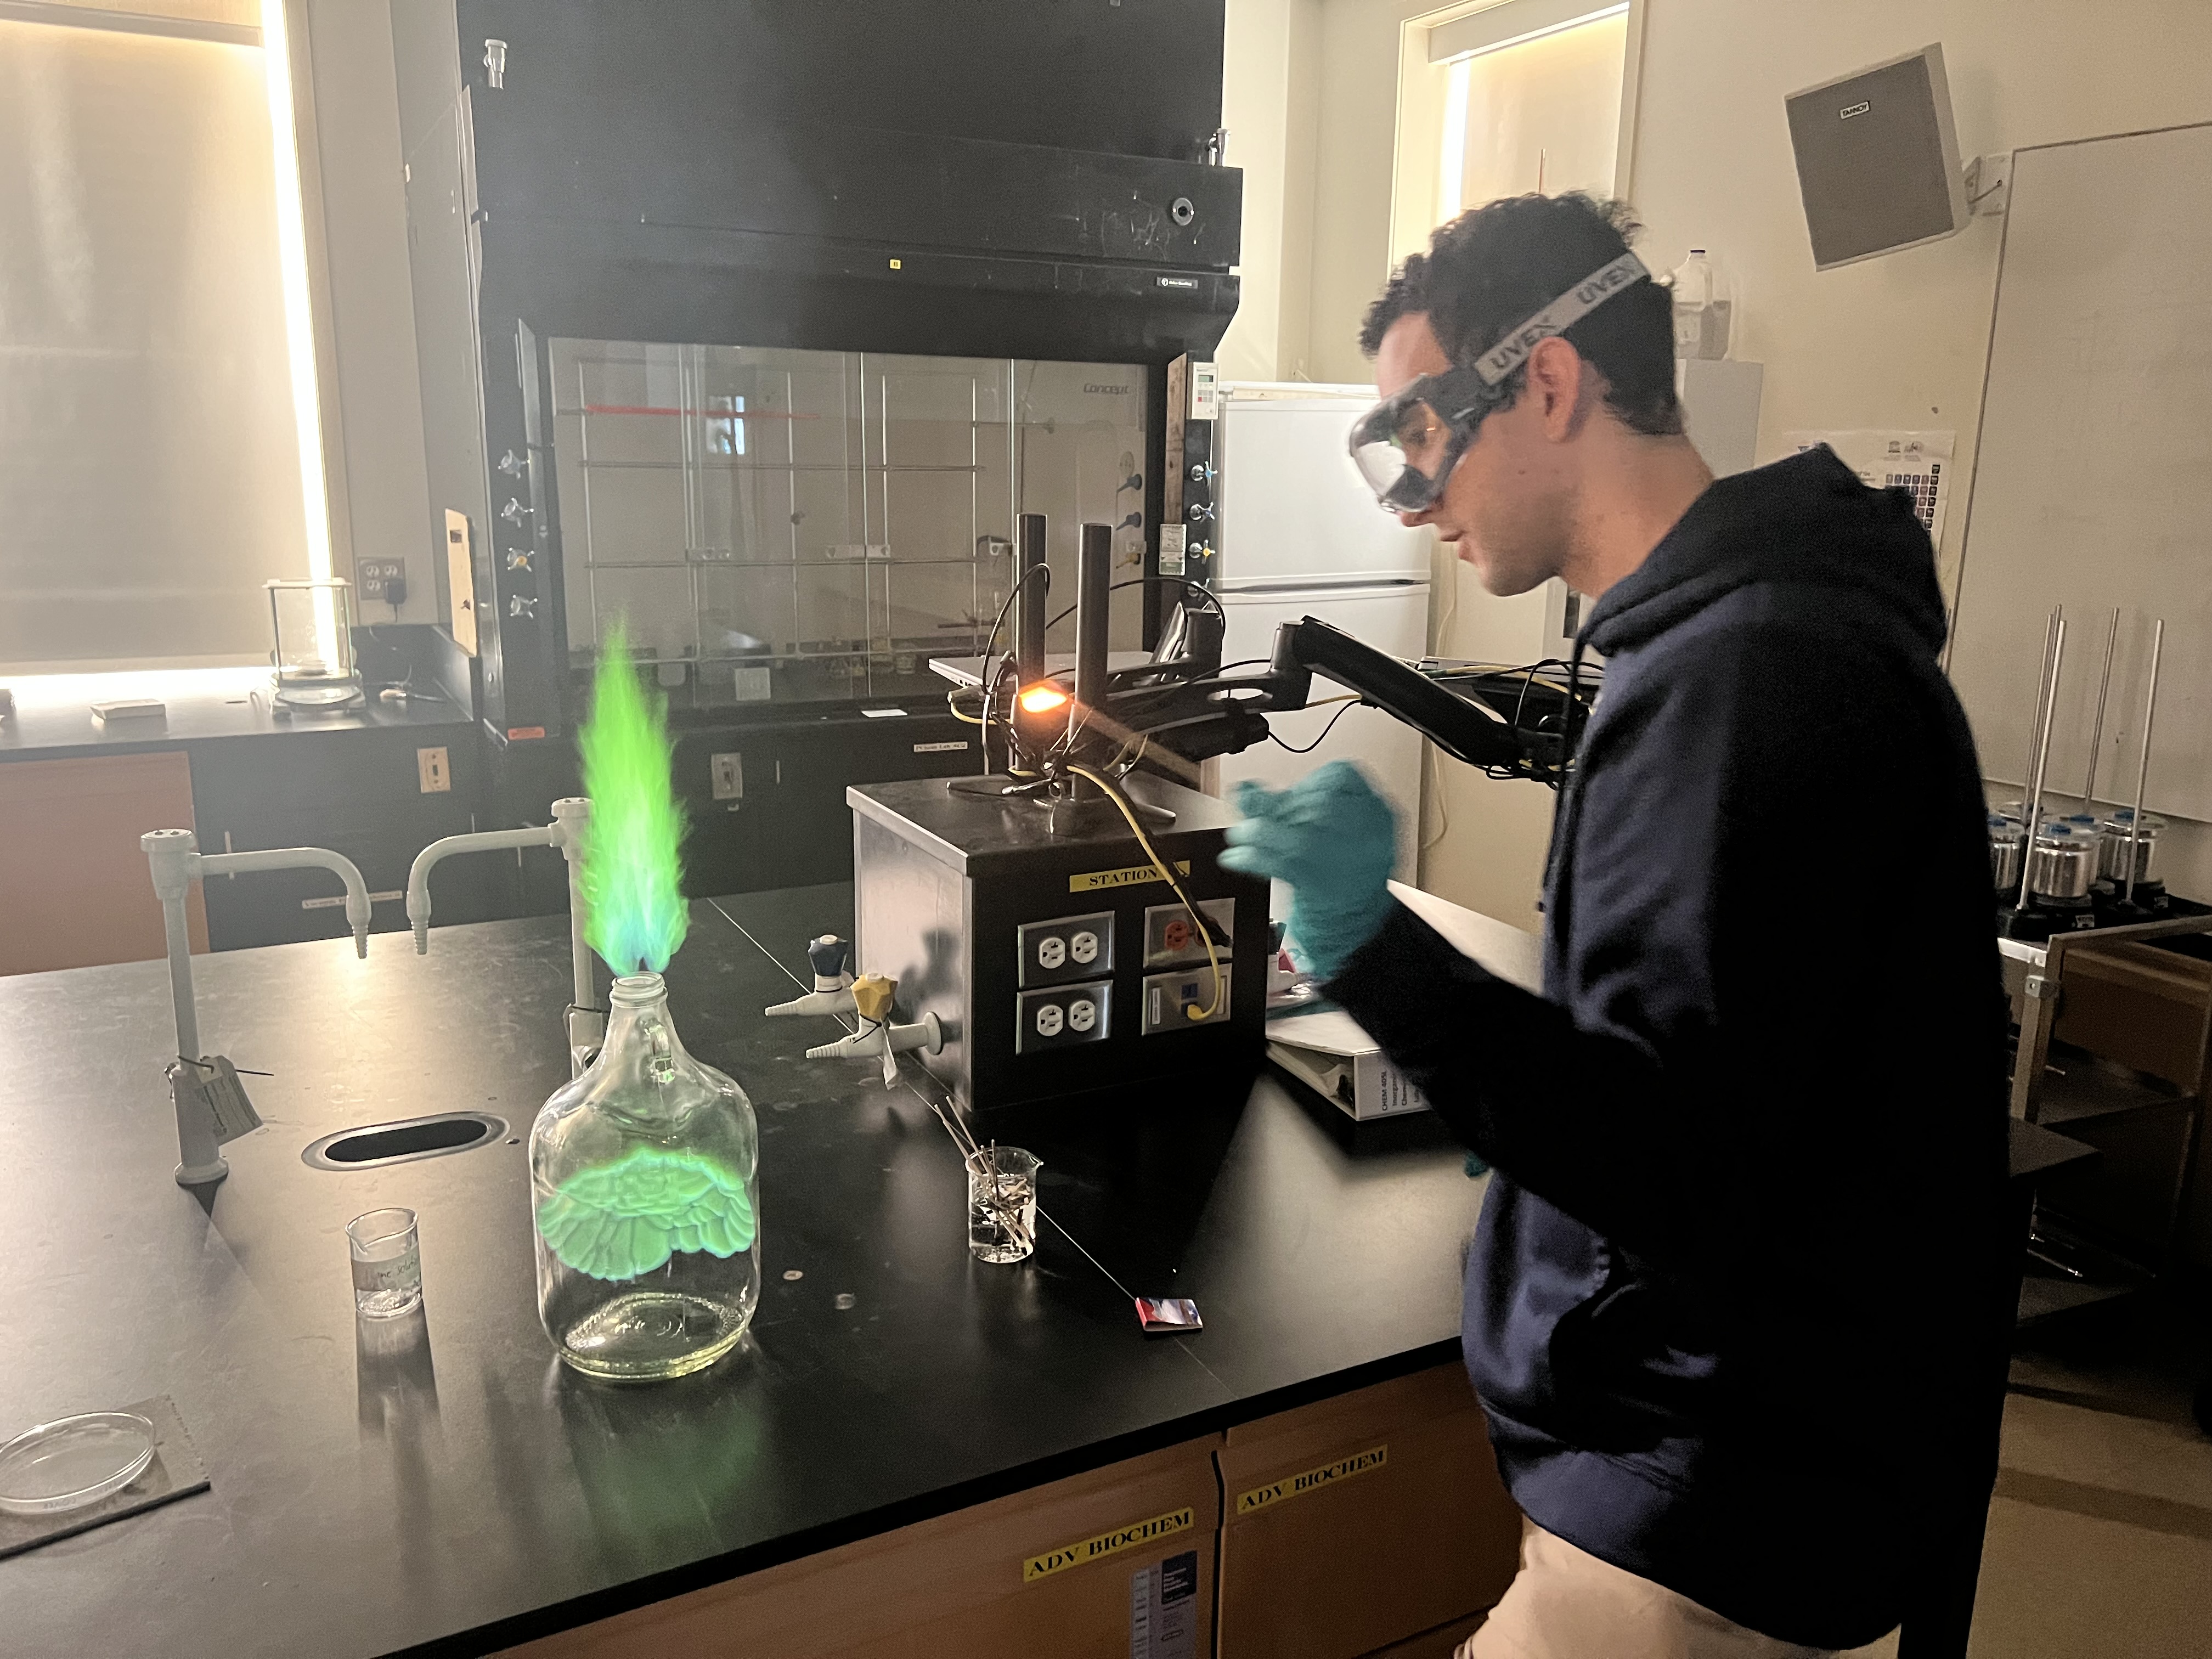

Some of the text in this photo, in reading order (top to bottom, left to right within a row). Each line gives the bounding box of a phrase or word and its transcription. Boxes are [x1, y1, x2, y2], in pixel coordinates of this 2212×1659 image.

[1577, 266, 1635, 305] UVEX
[1084, 383, 1128, 394] Concept
[1089, 867, 1158, 886] STATION
[1242, 1450, 1384, 1510] ADV BIOCHEM
[1028, 1511, 1189, 1577] ADV BIOCHEM
